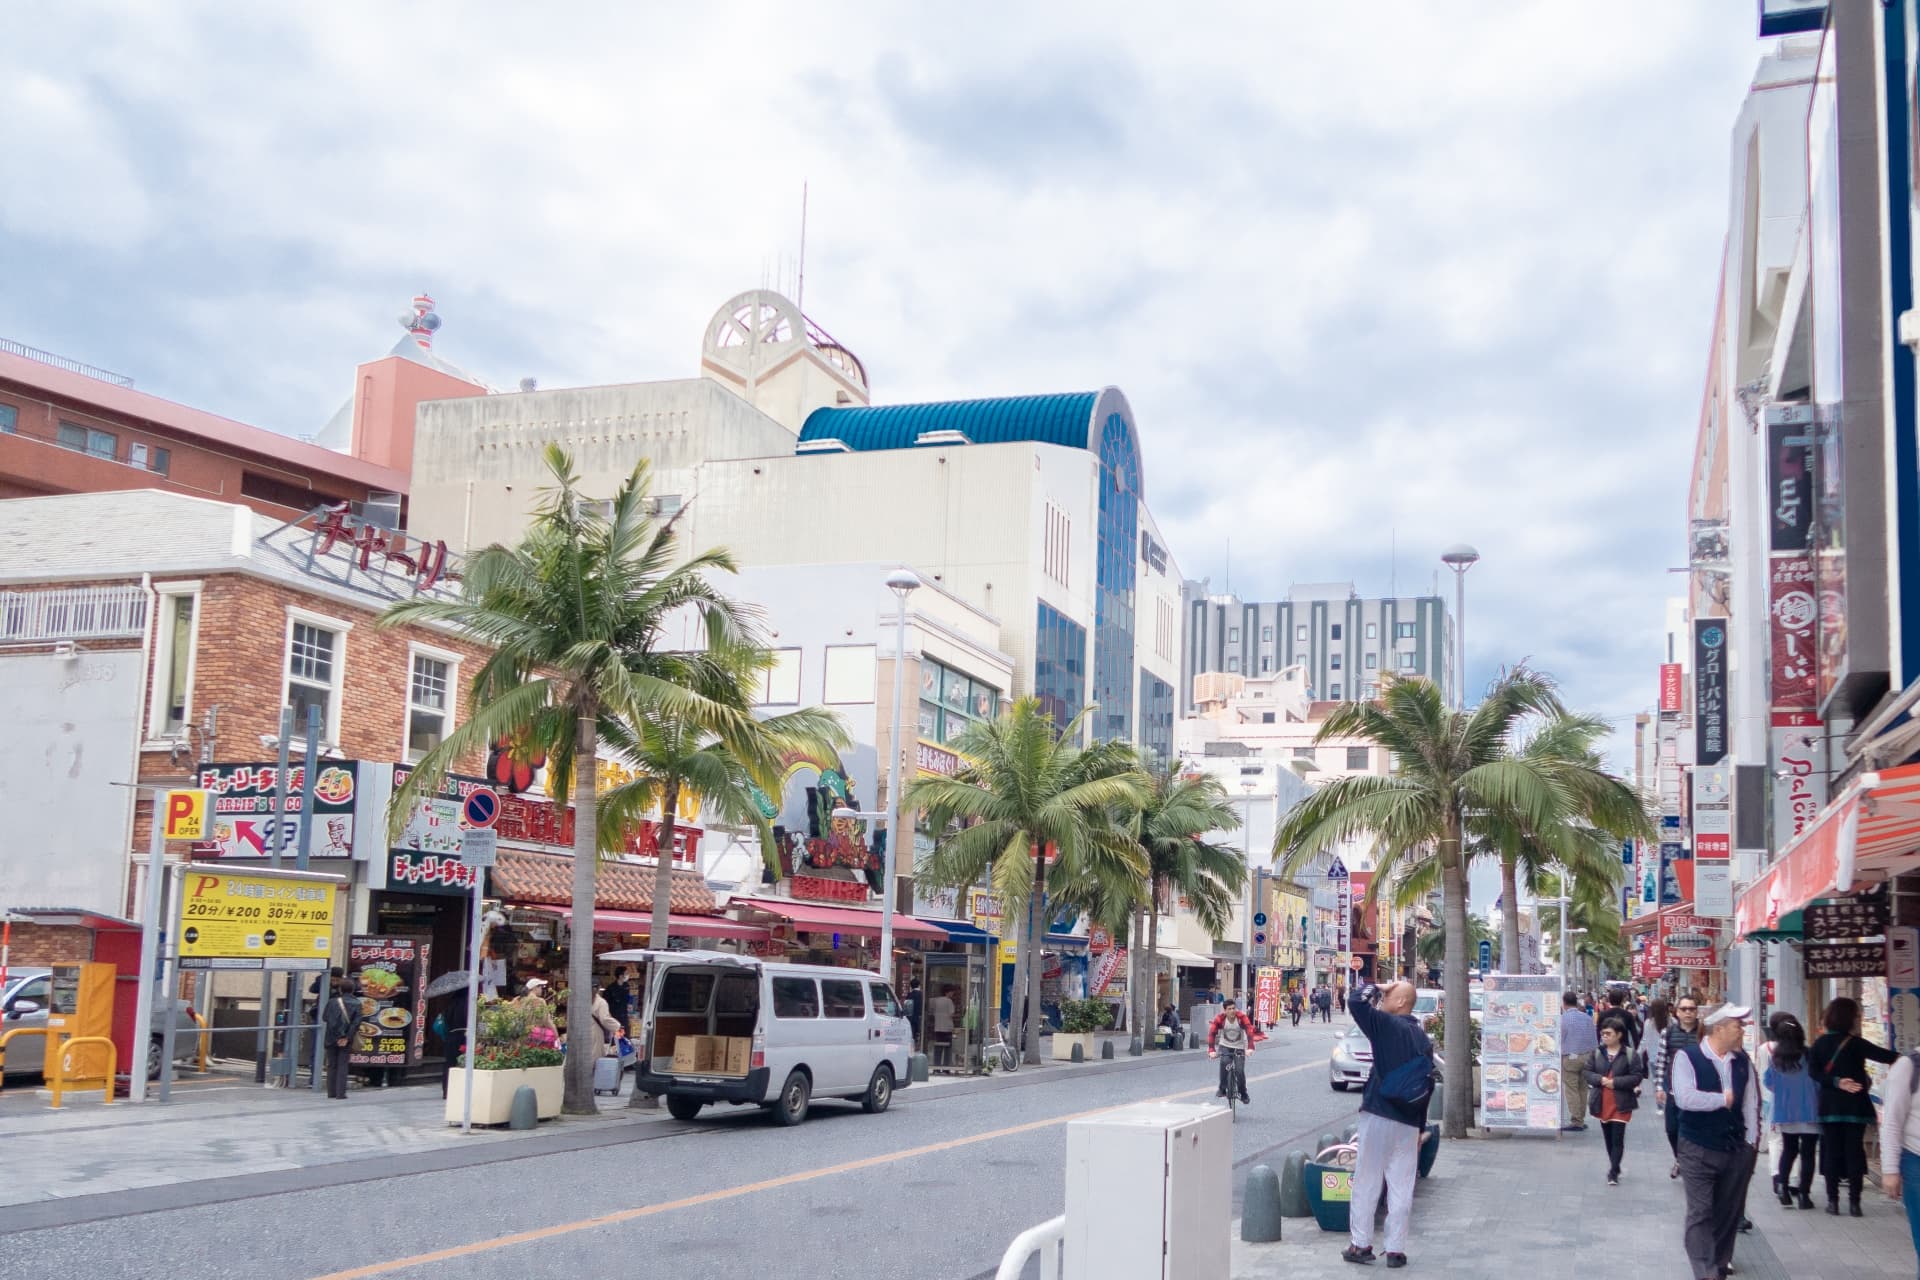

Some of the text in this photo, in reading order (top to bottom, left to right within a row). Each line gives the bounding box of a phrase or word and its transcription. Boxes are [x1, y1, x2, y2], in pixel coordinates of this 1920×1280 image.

[201, 766, 304, 793] チャーリー多寿
[215, 797, 304, 811] ARLIE'S TCO
[168, 794, 194, 834] P
[188, 817, 199, 825] 24
[192, 876, 220, 897] P
[378, 1044, 406, 1053] 21:00
